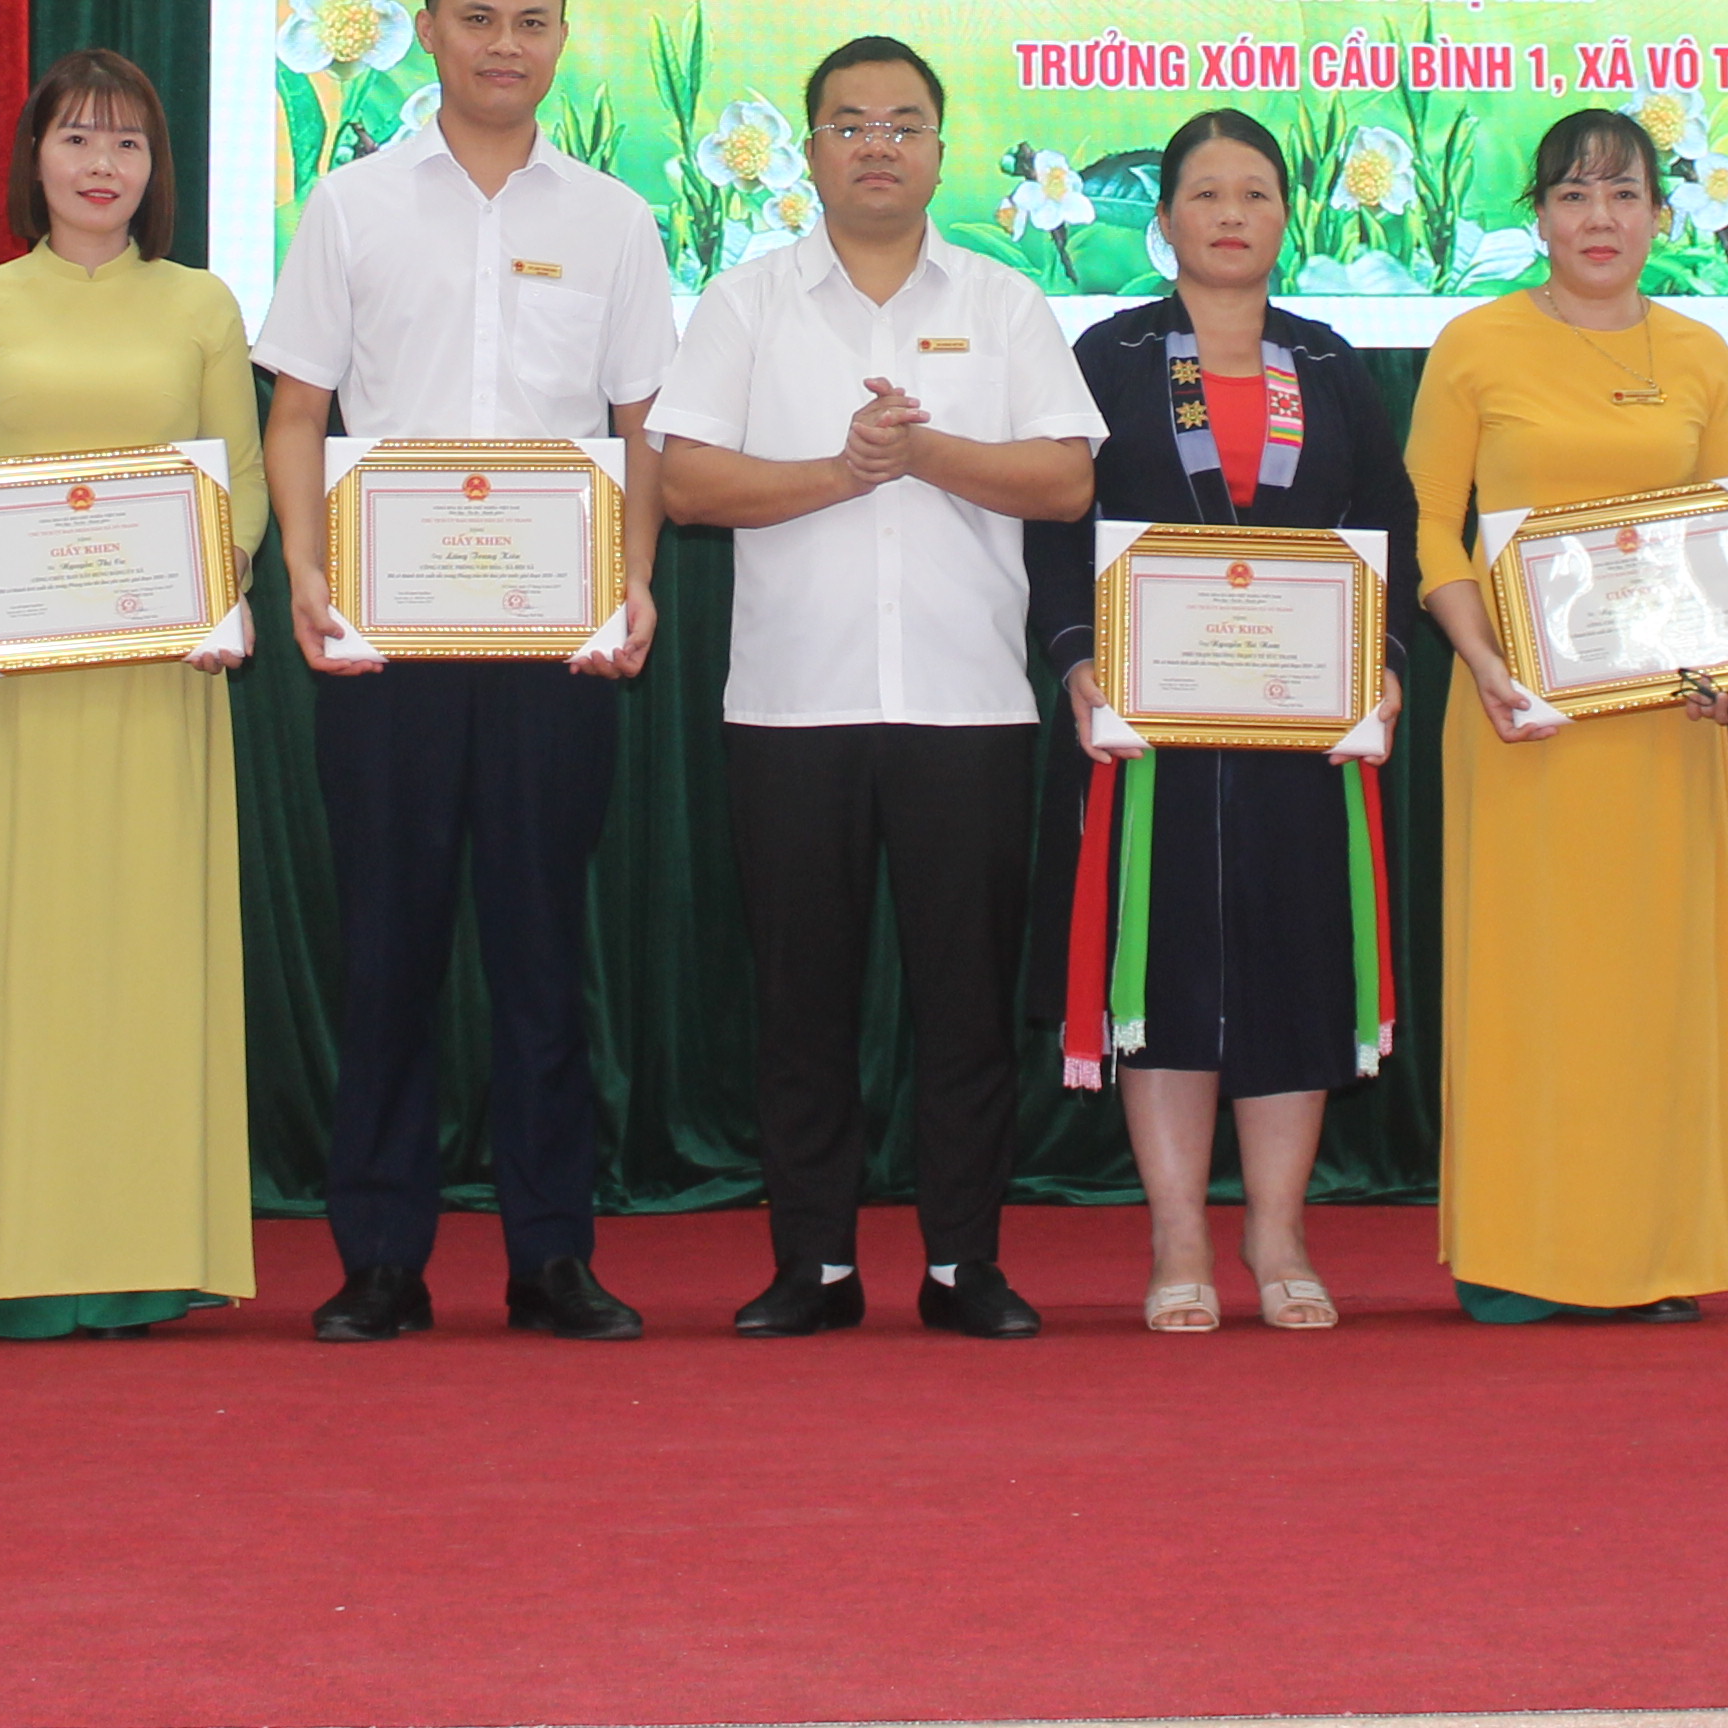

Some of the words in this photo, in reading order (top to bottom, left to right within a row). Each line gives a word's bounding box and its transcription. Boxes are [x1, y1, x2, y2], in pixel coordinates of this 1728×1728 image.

[1016, 31, 1186, 88] TRƯỞNG
[1202, 36, 1299, 88] XÓM
[1312, 30, 1396, 88] CẦU
[1411, 38, 1512, 89] BÌNH
[1528, 47, 1565, 95] 1,
[1578, 39, 1634, 89] XÃ
[1647, 39, 1700, 89] VÔ
[475, 536, 512, 546] KHEN
[83, 543, 120, 554] KHEN
